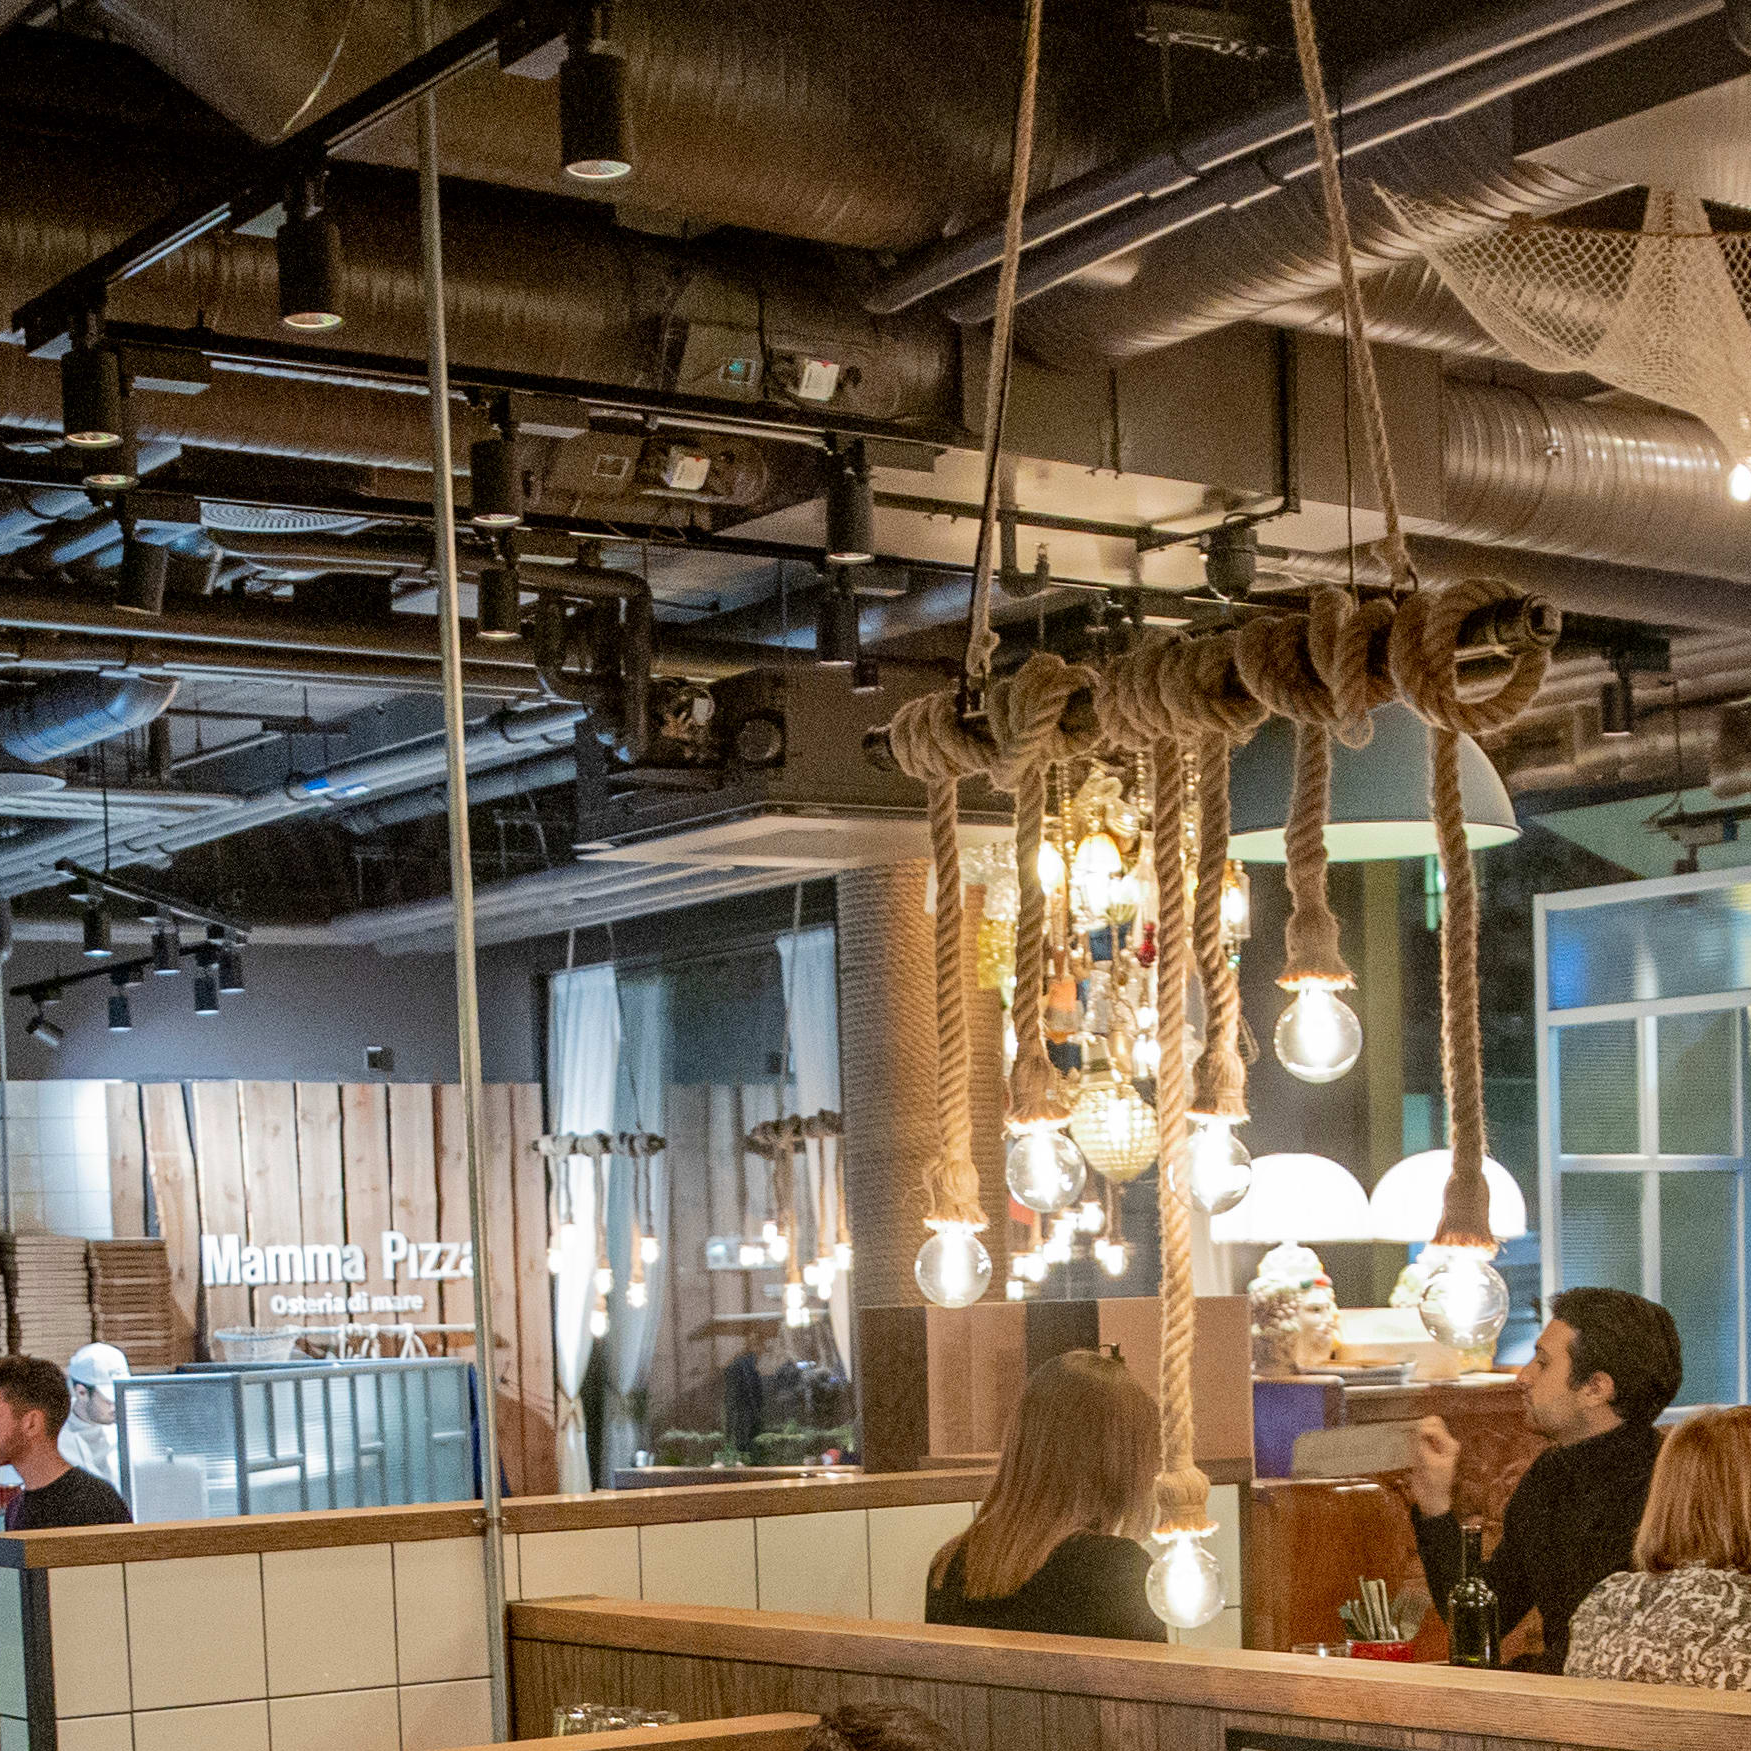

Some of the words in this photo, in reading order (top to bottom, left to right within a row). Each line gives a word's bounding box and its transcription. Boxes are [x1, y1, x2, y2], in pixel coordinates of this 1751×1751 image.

[202, 1233, 366, 1287] Mamma
[270, 1292, 346, 1315] Osteria
[347, 1291, 369, 1313] di
[371, 1294, 424, 1312] mare
